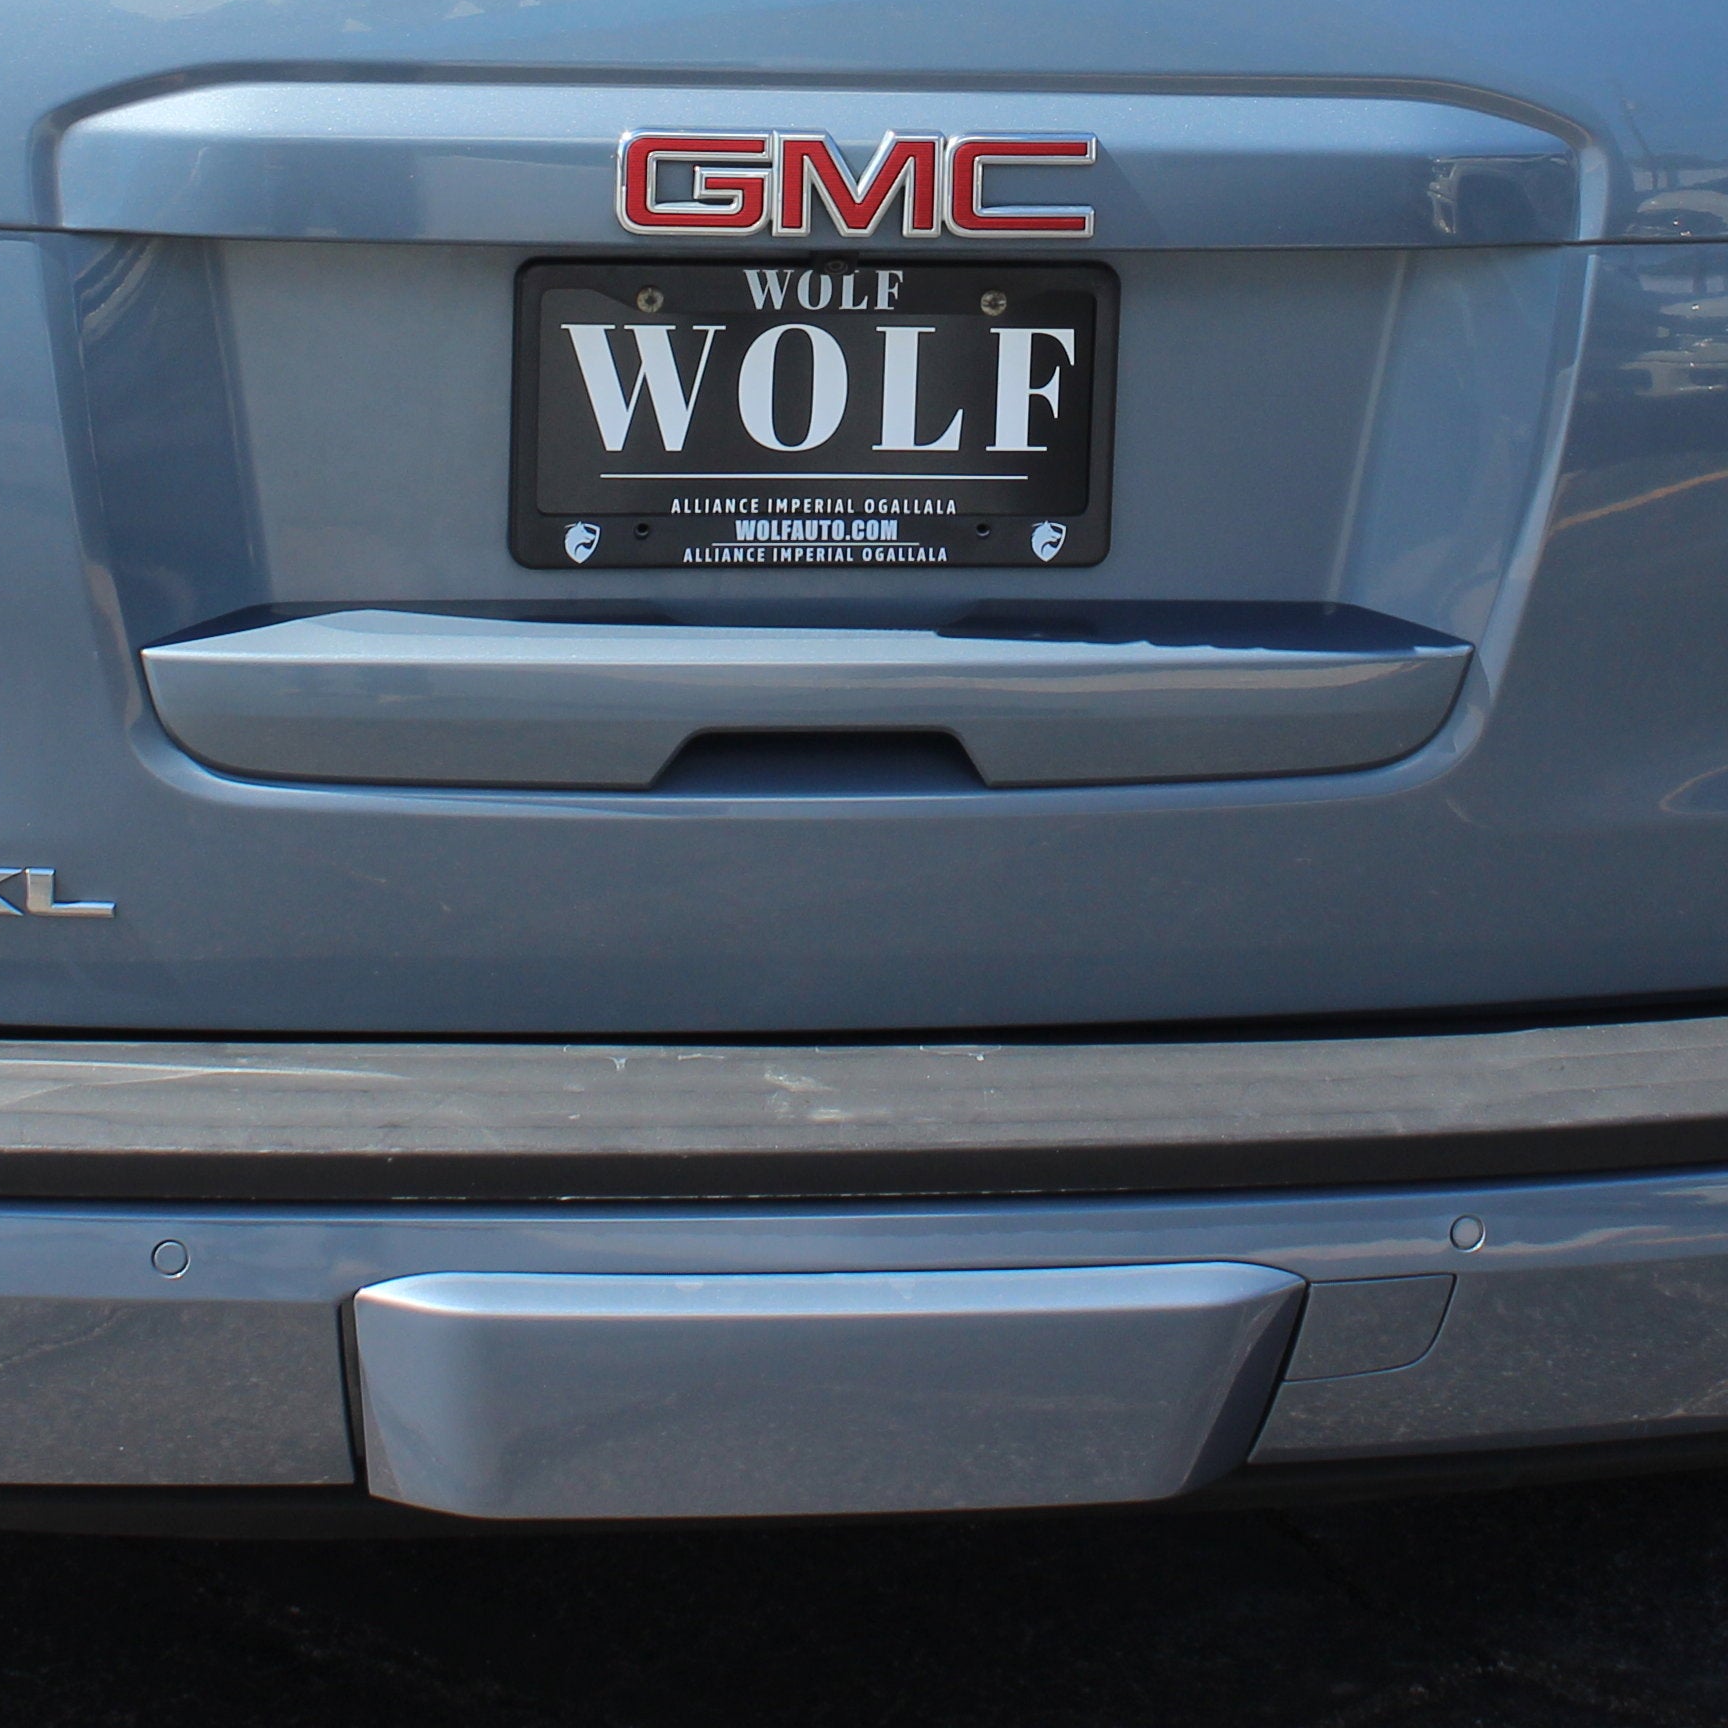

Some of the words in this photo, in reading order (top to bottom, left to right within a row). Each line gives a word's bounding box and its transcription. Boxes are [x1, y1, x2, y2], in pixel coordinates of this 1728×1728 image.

[614, 127, 1097, 238] GMC
[743, 269, 904, 311] WOLF
[560, 323, 1075, 452] WOLF
[671, 498, 759, 514] ALLIANCE
[767, 498, 855, 514] IMPERIAL
[864, 498, 957, 515] OGALLALA
[735, 520, 898, 541] WOLFAUTO.COM
[683, 547, 765, 563] ALLIANCE
[773, 547, 854, 562] IMPERIAL
[862, 547, 948, 562] OGALLALA
